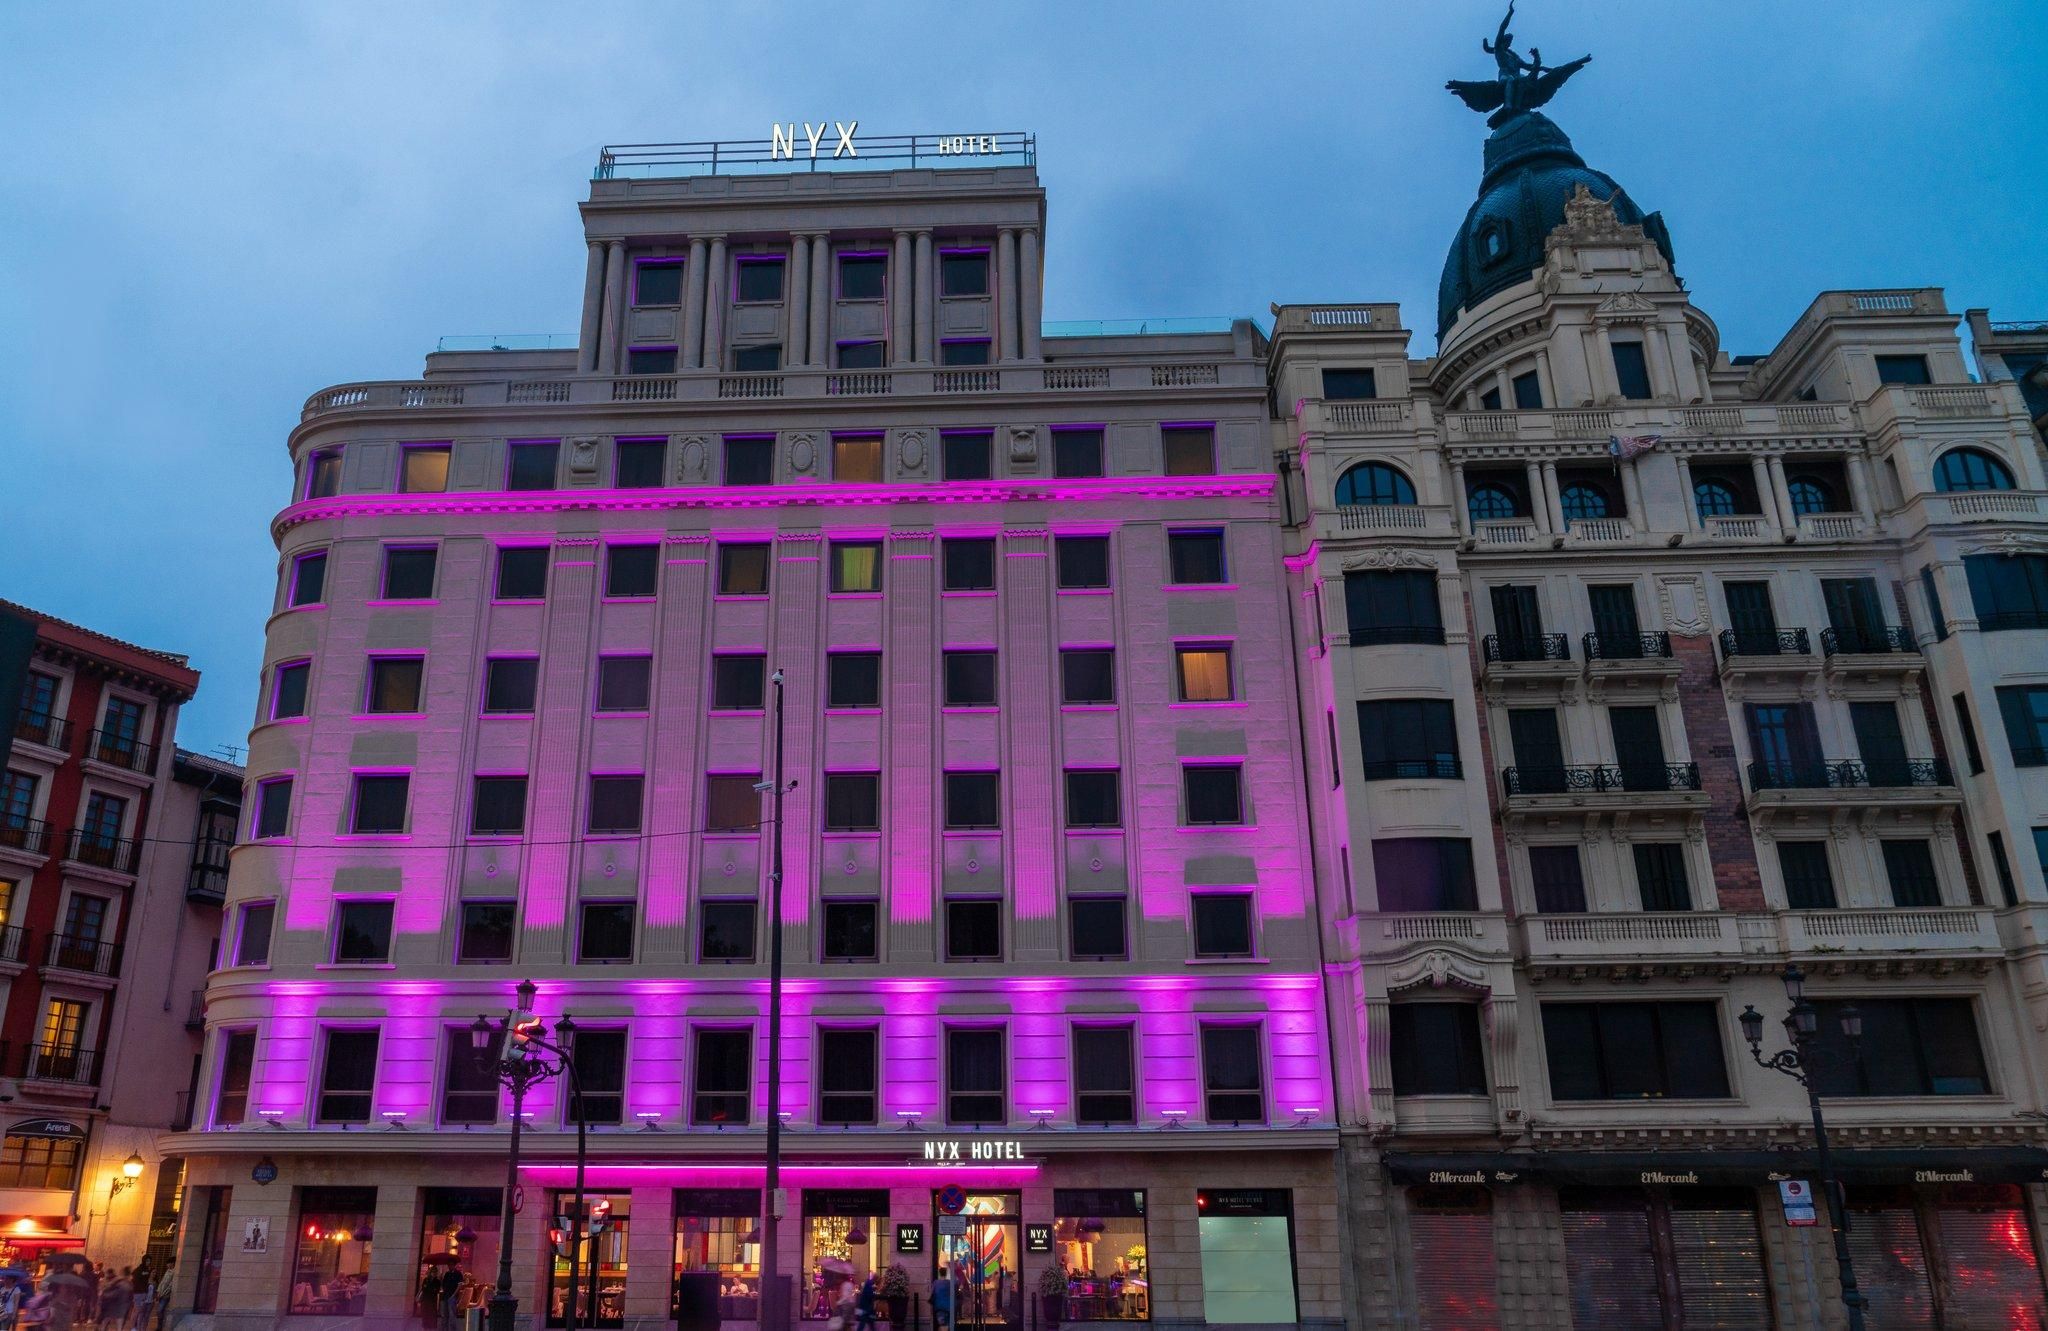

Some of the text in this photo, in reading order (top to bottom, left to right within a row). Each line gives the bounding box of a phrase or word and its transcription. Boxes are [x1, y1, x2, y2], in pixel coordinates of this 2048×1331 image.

[771, 121, 1002, 160] NYX HOTEL
[45, 1122, 71, 1132] Arenal
[924, 1141, 1025, 1160] NYX HOTEL
[901, 1229, 919, 1239] NYX
[1030, 1229, 1048, 1239] NYX
